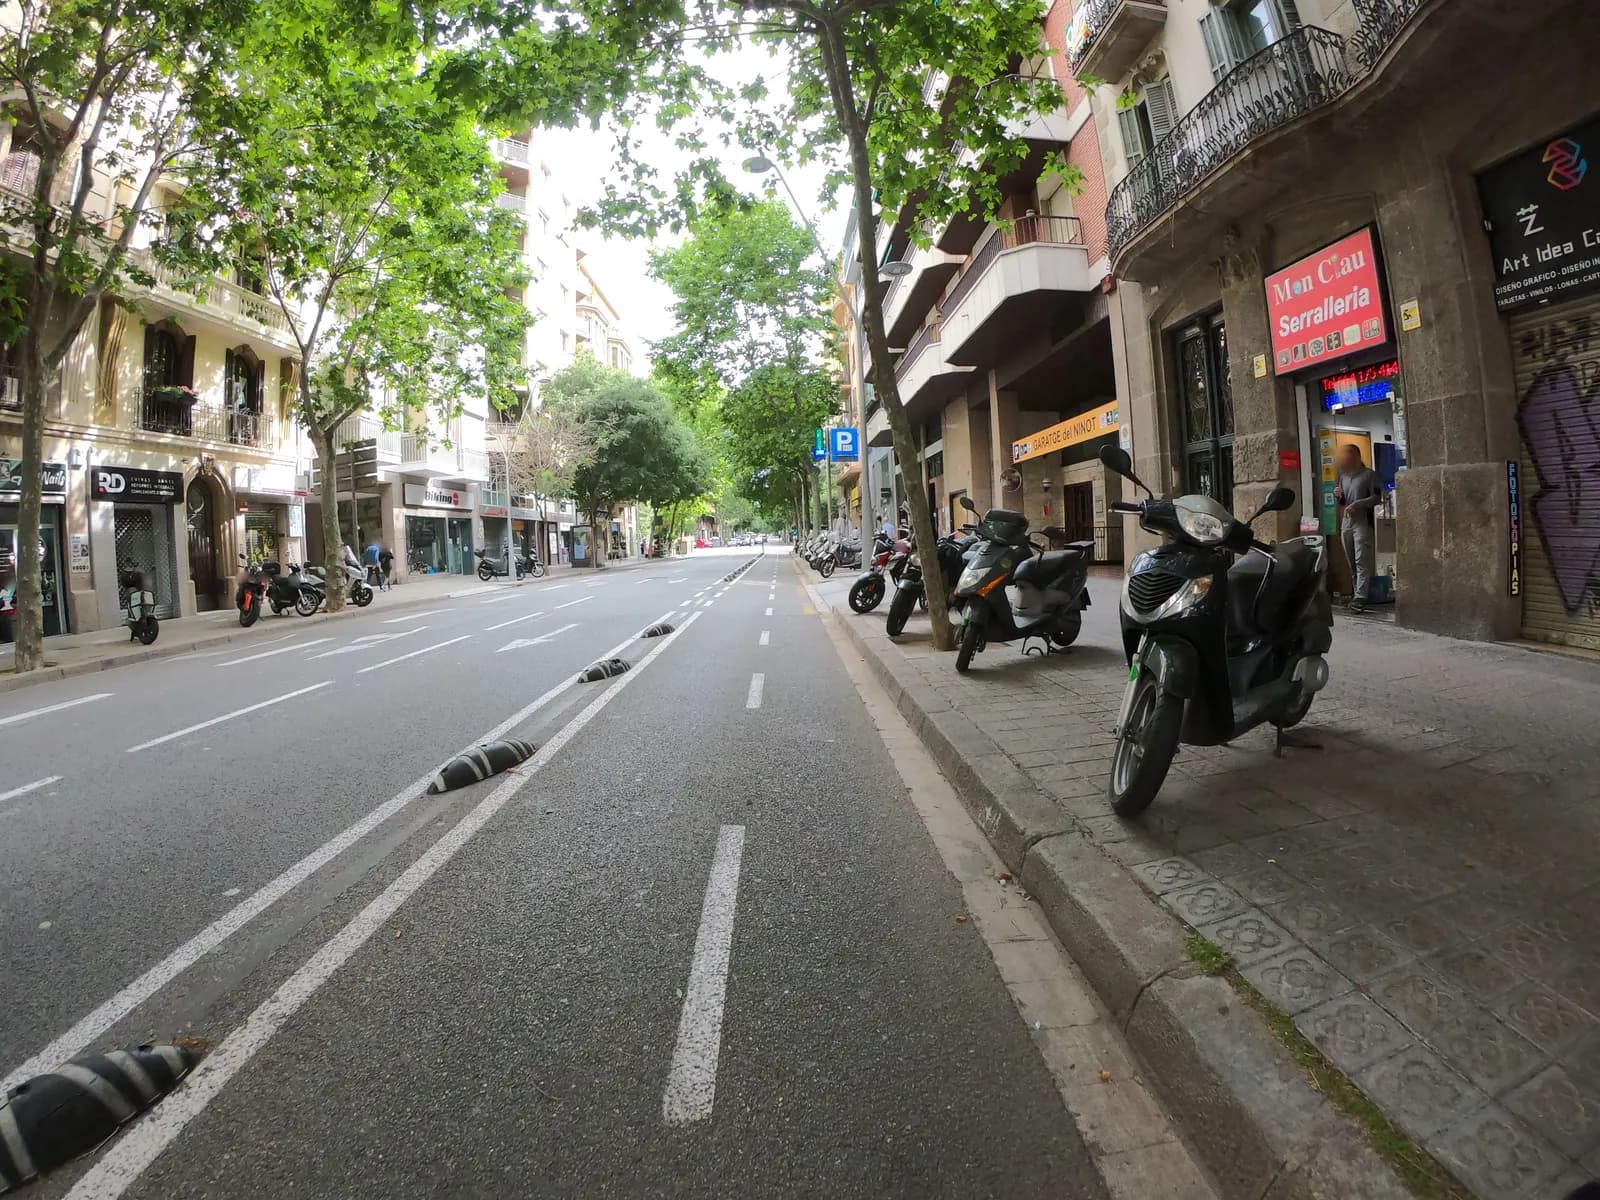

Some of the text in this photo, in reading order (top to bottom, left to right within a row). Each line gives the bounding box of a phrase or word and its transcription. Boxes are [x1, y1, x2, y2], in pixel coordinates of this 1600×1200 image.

[1502, 253, 1530, 275] Art
[1536, 242, 1574, 263] Idea
[1273, 250, 1366, 306] Mon Clau
[1495, 280, 1521, 295] DISEÑO
[1522, 270, 1557, 287] GRAFICO
[1561, 259, 1592, 276] DISEÑO
[1497, 293, 1526, 305] TARJETAS
[1529, 285, 1553, 297] VINILOS
[1557, 278, 1579, 290] LONAS
[1278, 286, 1370, 337] Serralleria
[837, 431, 853, 451] P
[1033, 430, 1061, 451] GARATGE
[1062, 427, 1072, 441] del
[1073, 417, 1097, 437] NINOT
[41, 470, 65, 486] Nails
[98, 472, 126, 493] RD
[1509, 463, 1519, 595] FOTOCOPIAS
